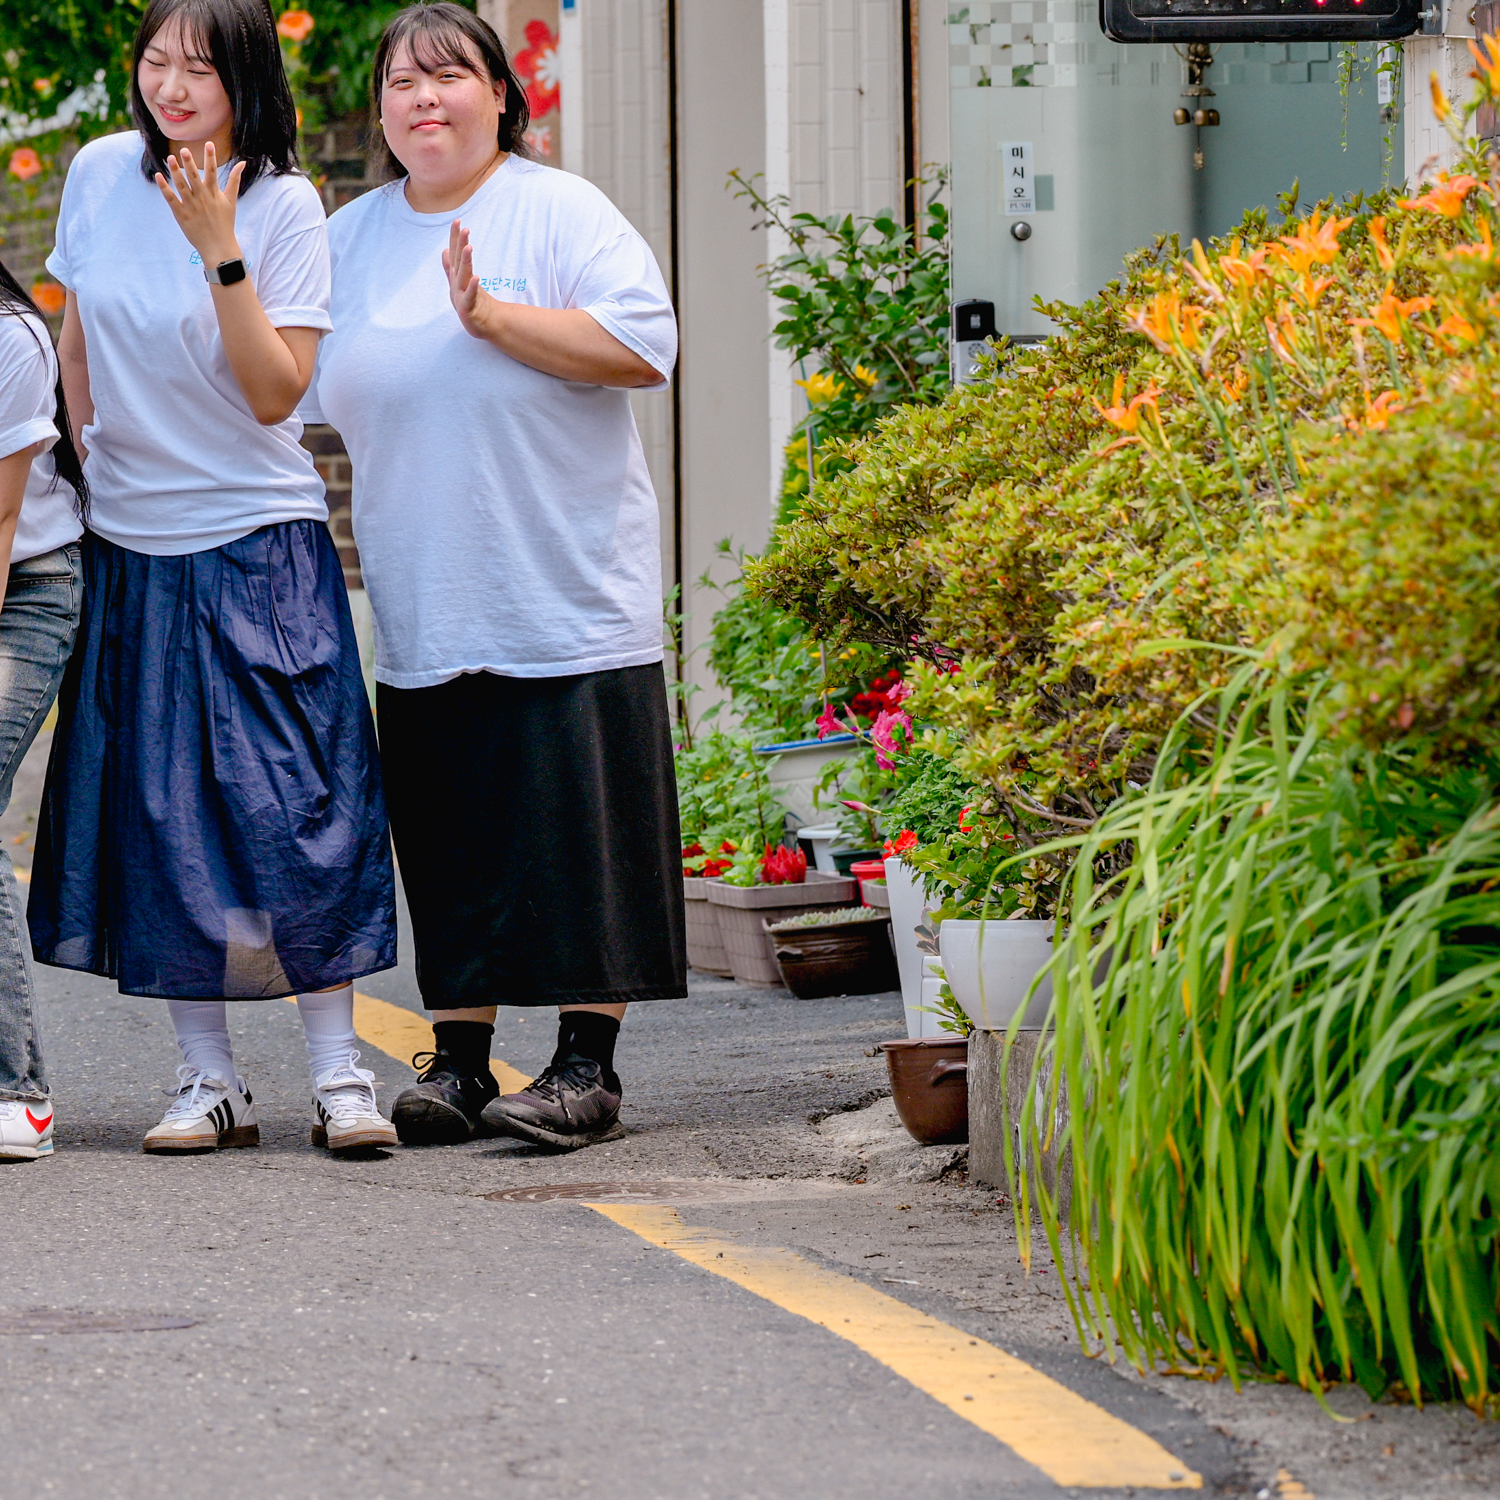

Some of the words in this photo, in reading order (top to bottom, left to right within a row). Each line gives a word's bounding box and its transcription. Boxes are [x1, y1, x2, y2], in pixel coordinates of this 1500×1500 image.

[1011, 146, 1026, 198] 미시오
[1009, 202, 1032, 210] PUSH
[479, 276, 528, 292] 집단지성
